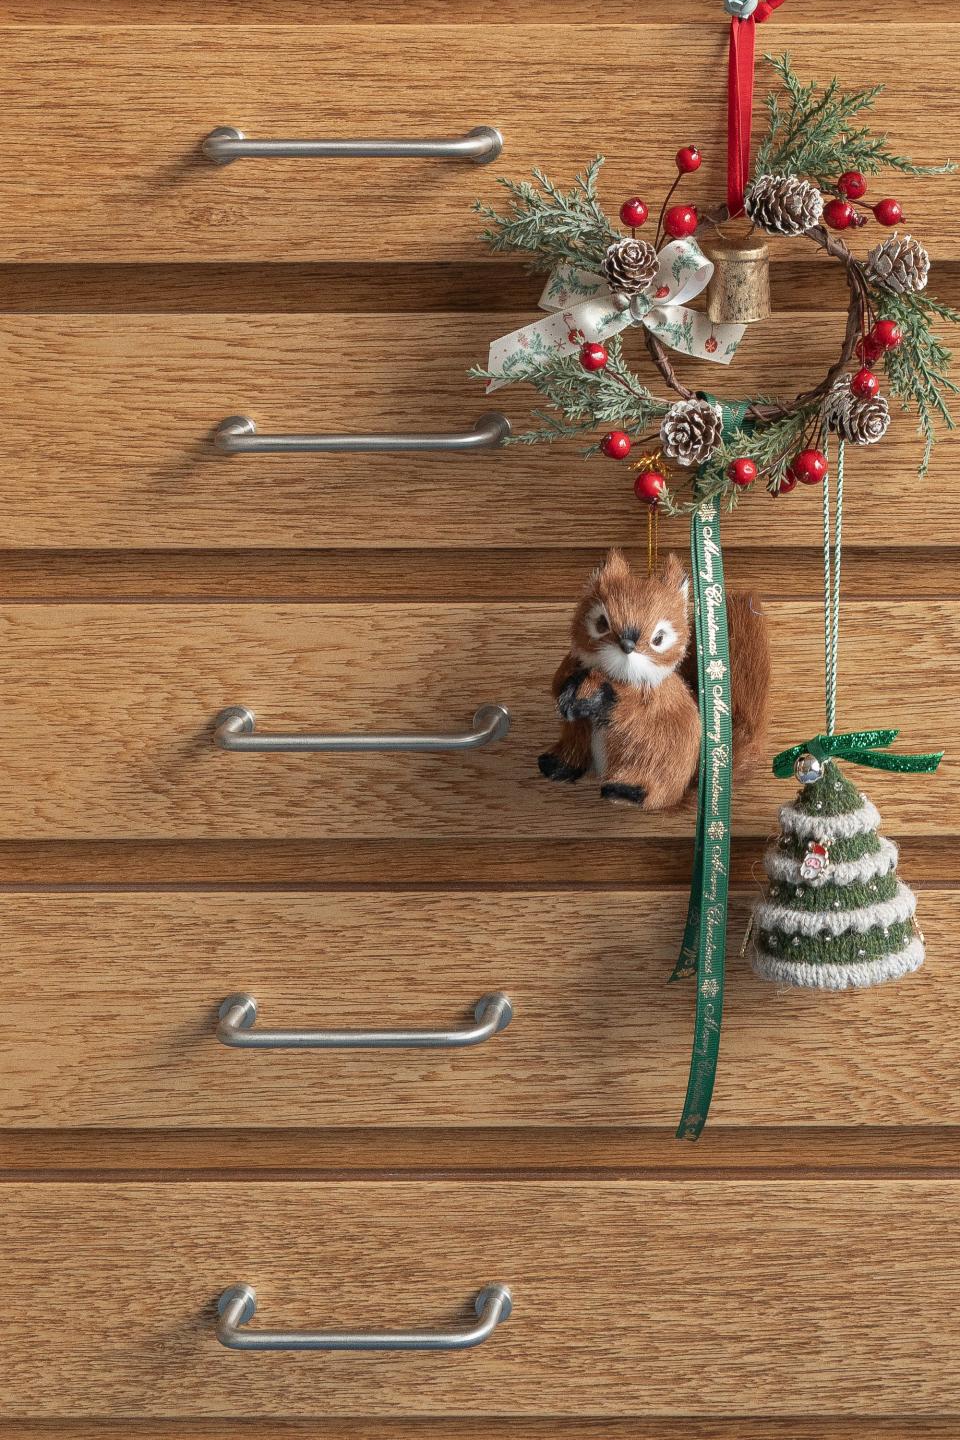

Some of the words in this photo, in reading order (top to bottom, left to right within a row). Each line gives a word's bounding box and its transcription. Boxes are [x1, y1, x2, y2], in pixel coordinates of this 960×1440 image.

[700, 526, 720, 583] Merry
[703, 584, 723, 656] Christmas
[707, 685, 729, 743] Merry
[711, 744, 730, 816] Christmas
[703, 846, 727, 901] Merry
[704, 903, 725, 974] Christmas
